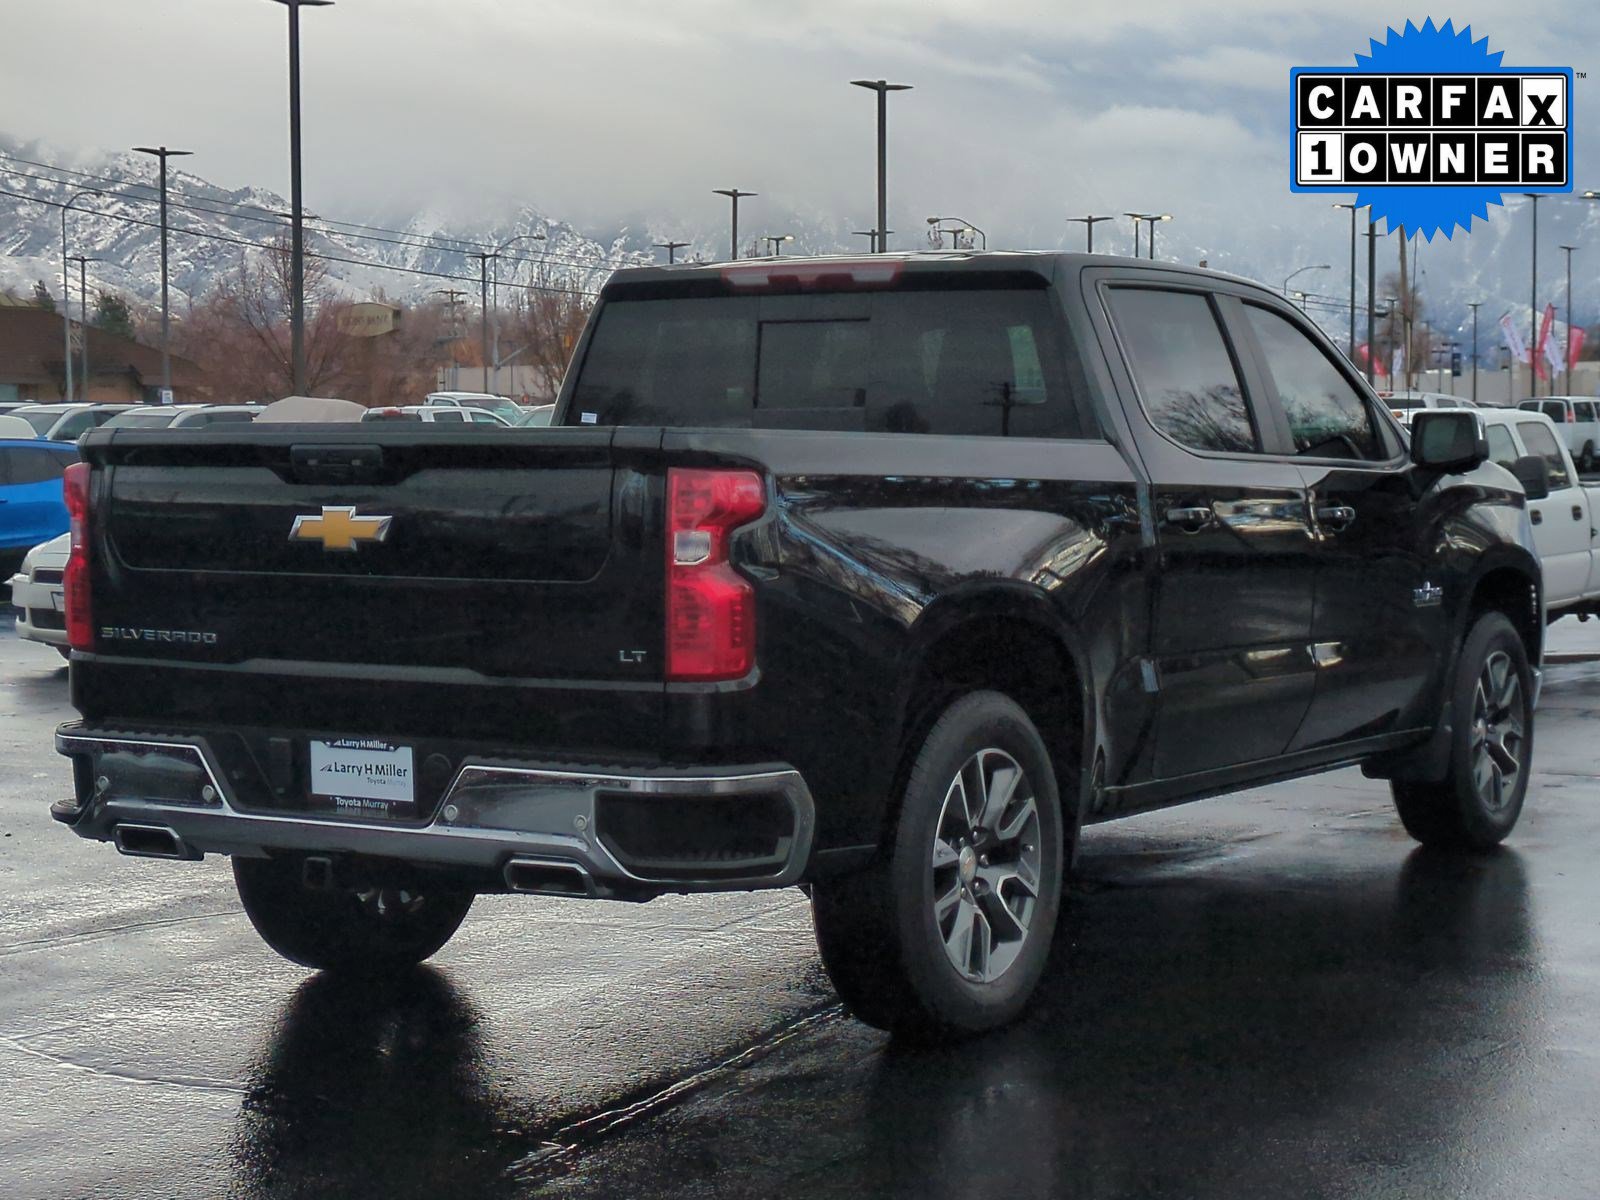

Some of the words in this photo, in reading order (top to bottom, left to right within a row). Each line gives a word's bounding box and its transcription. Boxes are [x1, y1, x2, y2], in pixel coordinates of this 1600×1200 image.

[101, 627, 217, 643] SILVERADO
[619, 650, 647, 662] LT
[341, 738, 360, 748] Larry
[360, 740, 366, 749] H
[366, 740, 387, 750] Miller
[334, 762, 362, 776] Larry
[364, 764, 373, 774] H
[375, 765, 408, 777] Miller
[336, 796, 361, 807] Toyota
[362, 799, 389, 810] Murray
